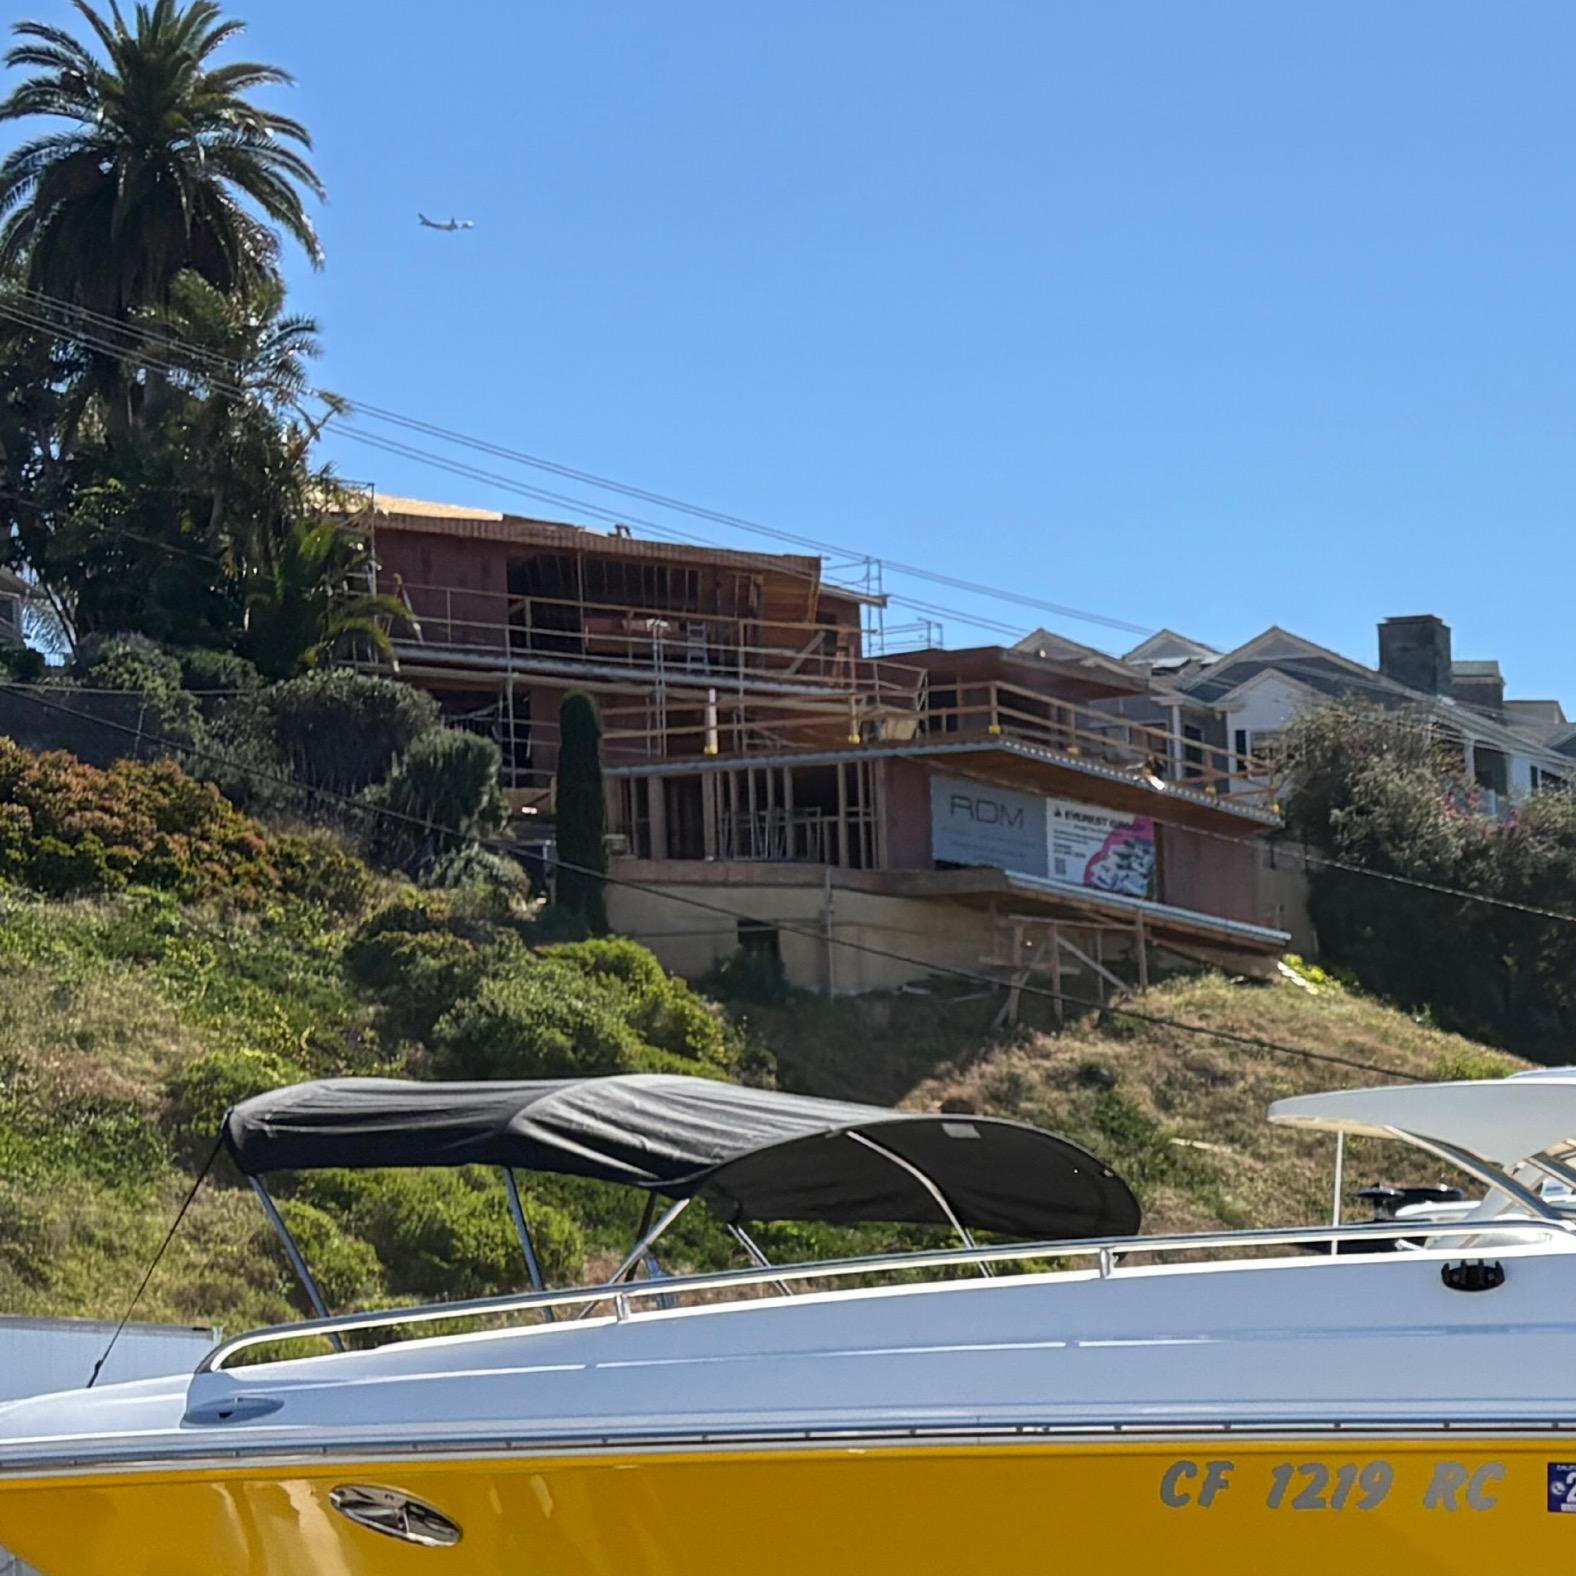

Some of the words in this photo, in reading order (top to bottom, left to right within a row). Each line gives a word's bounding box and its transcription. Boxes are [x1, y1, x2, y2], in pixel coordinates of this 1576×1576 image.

[1159, 1460, 1235, 1508] CF
[1265, 1460, 1395, 1510] 1219
[1423, 1461, 1507, 1512] RC
